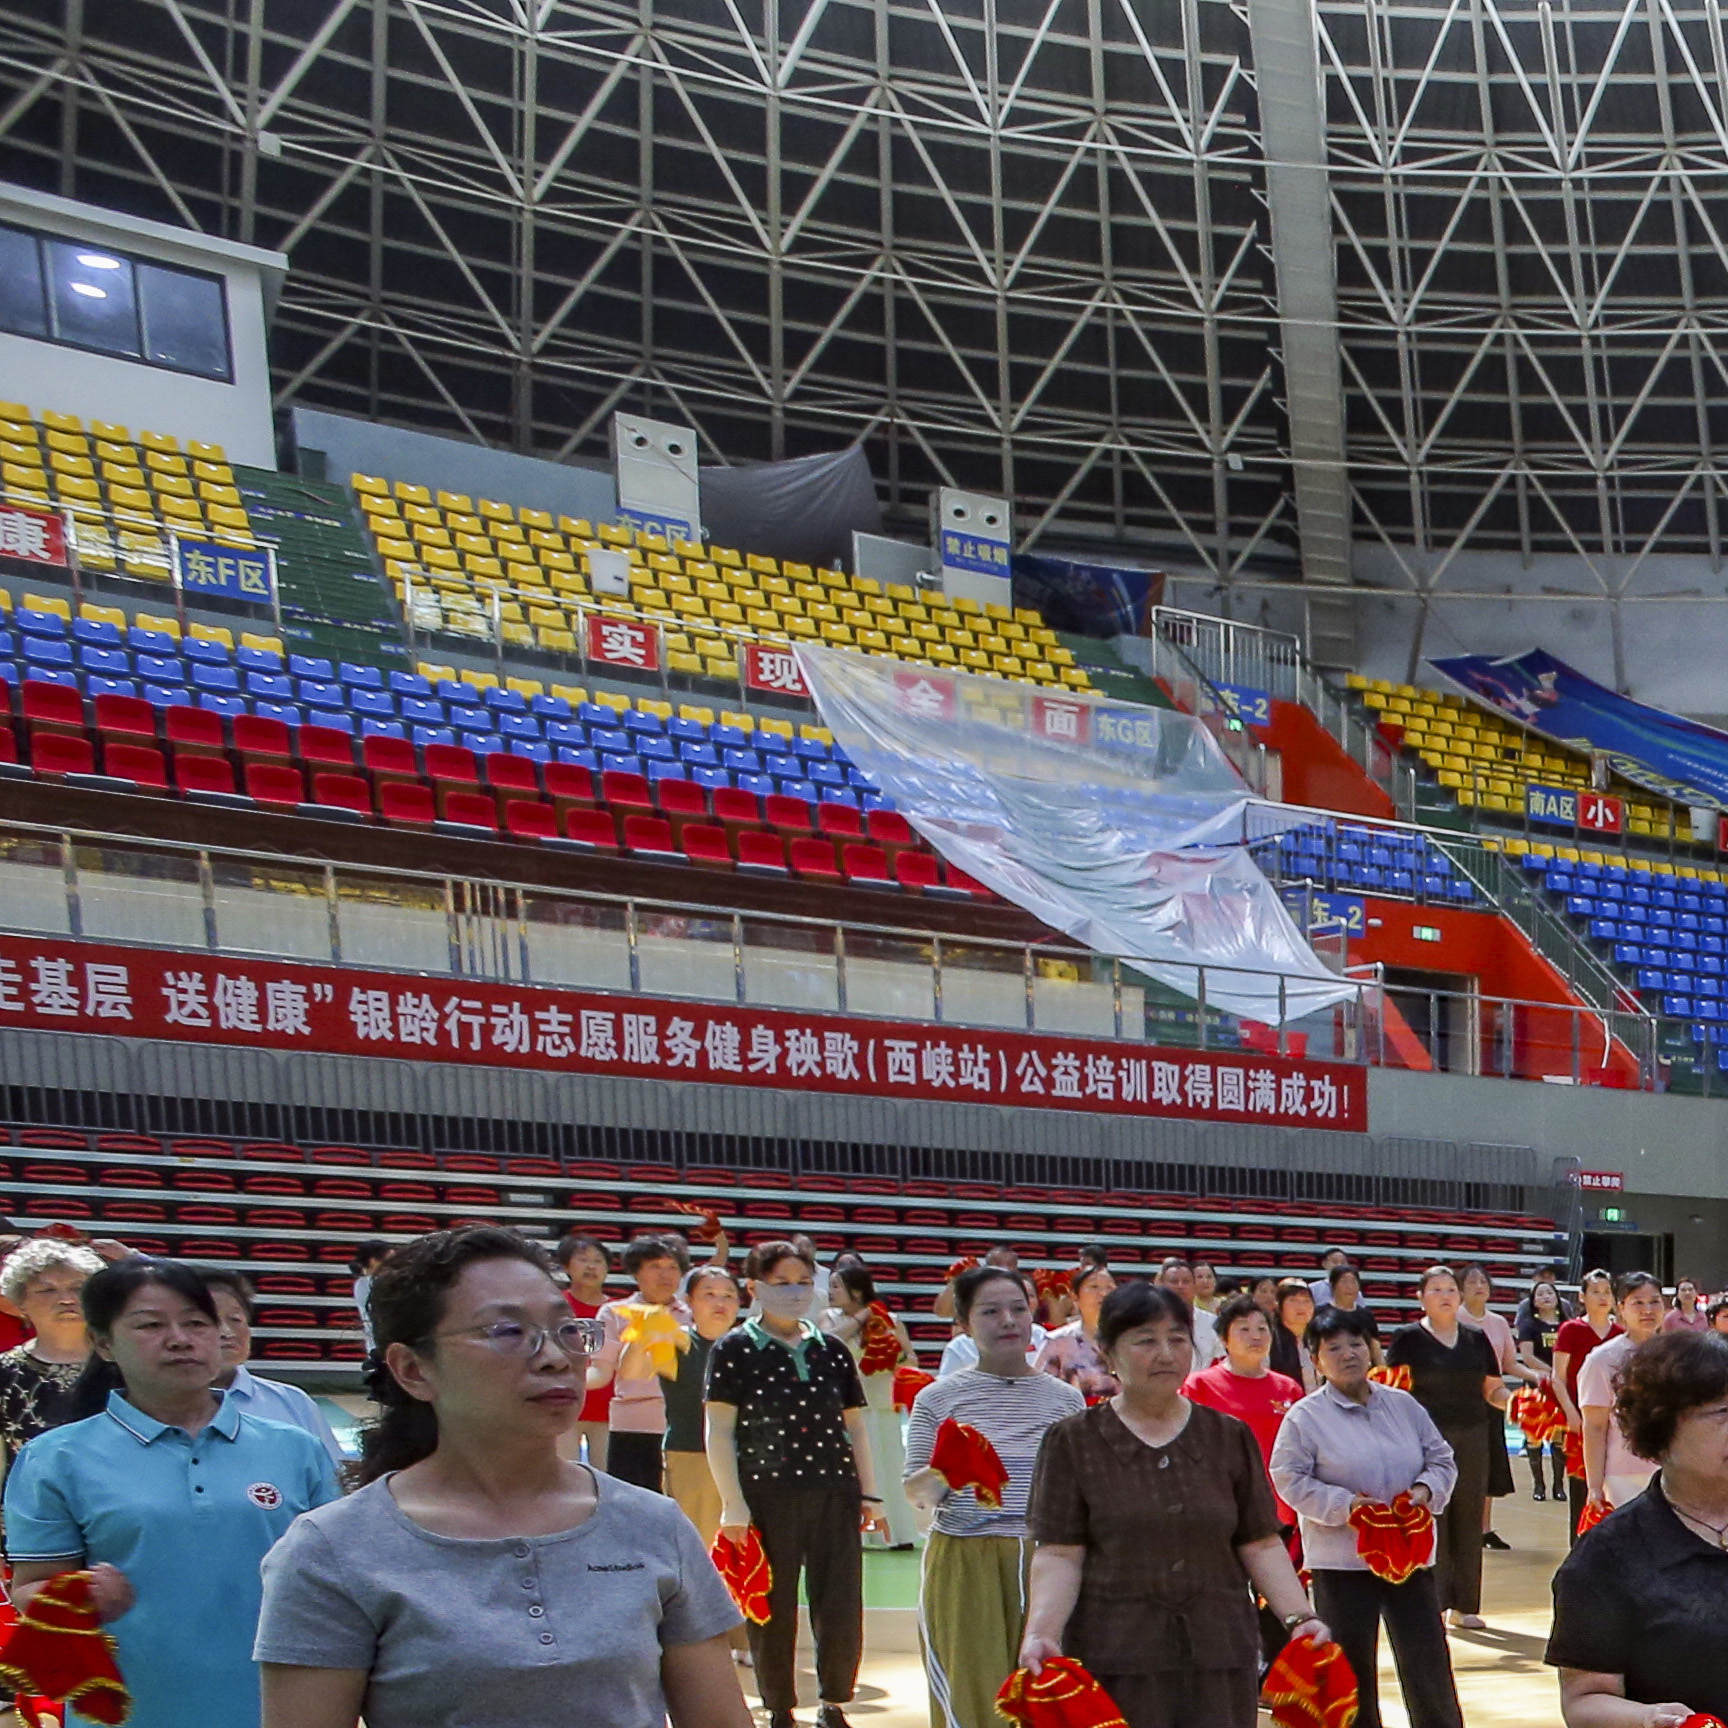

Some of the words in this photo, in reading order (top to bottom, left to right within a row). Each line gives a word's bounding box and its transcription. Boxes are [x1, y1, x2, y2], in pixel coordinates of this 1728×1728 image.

[0, 511, 51, 560] 康
[185, 549, 268, 596] 东F区
[601, 624, 646, 666] 实
[757, 650, 802, 691] 现
[1043, 701, 1079, 738] 面
[1586, 799, 1614, 827] 小
[1097, 713, 1153, 748] 东G区
[1529, 790, 1576, 821] 南A区
